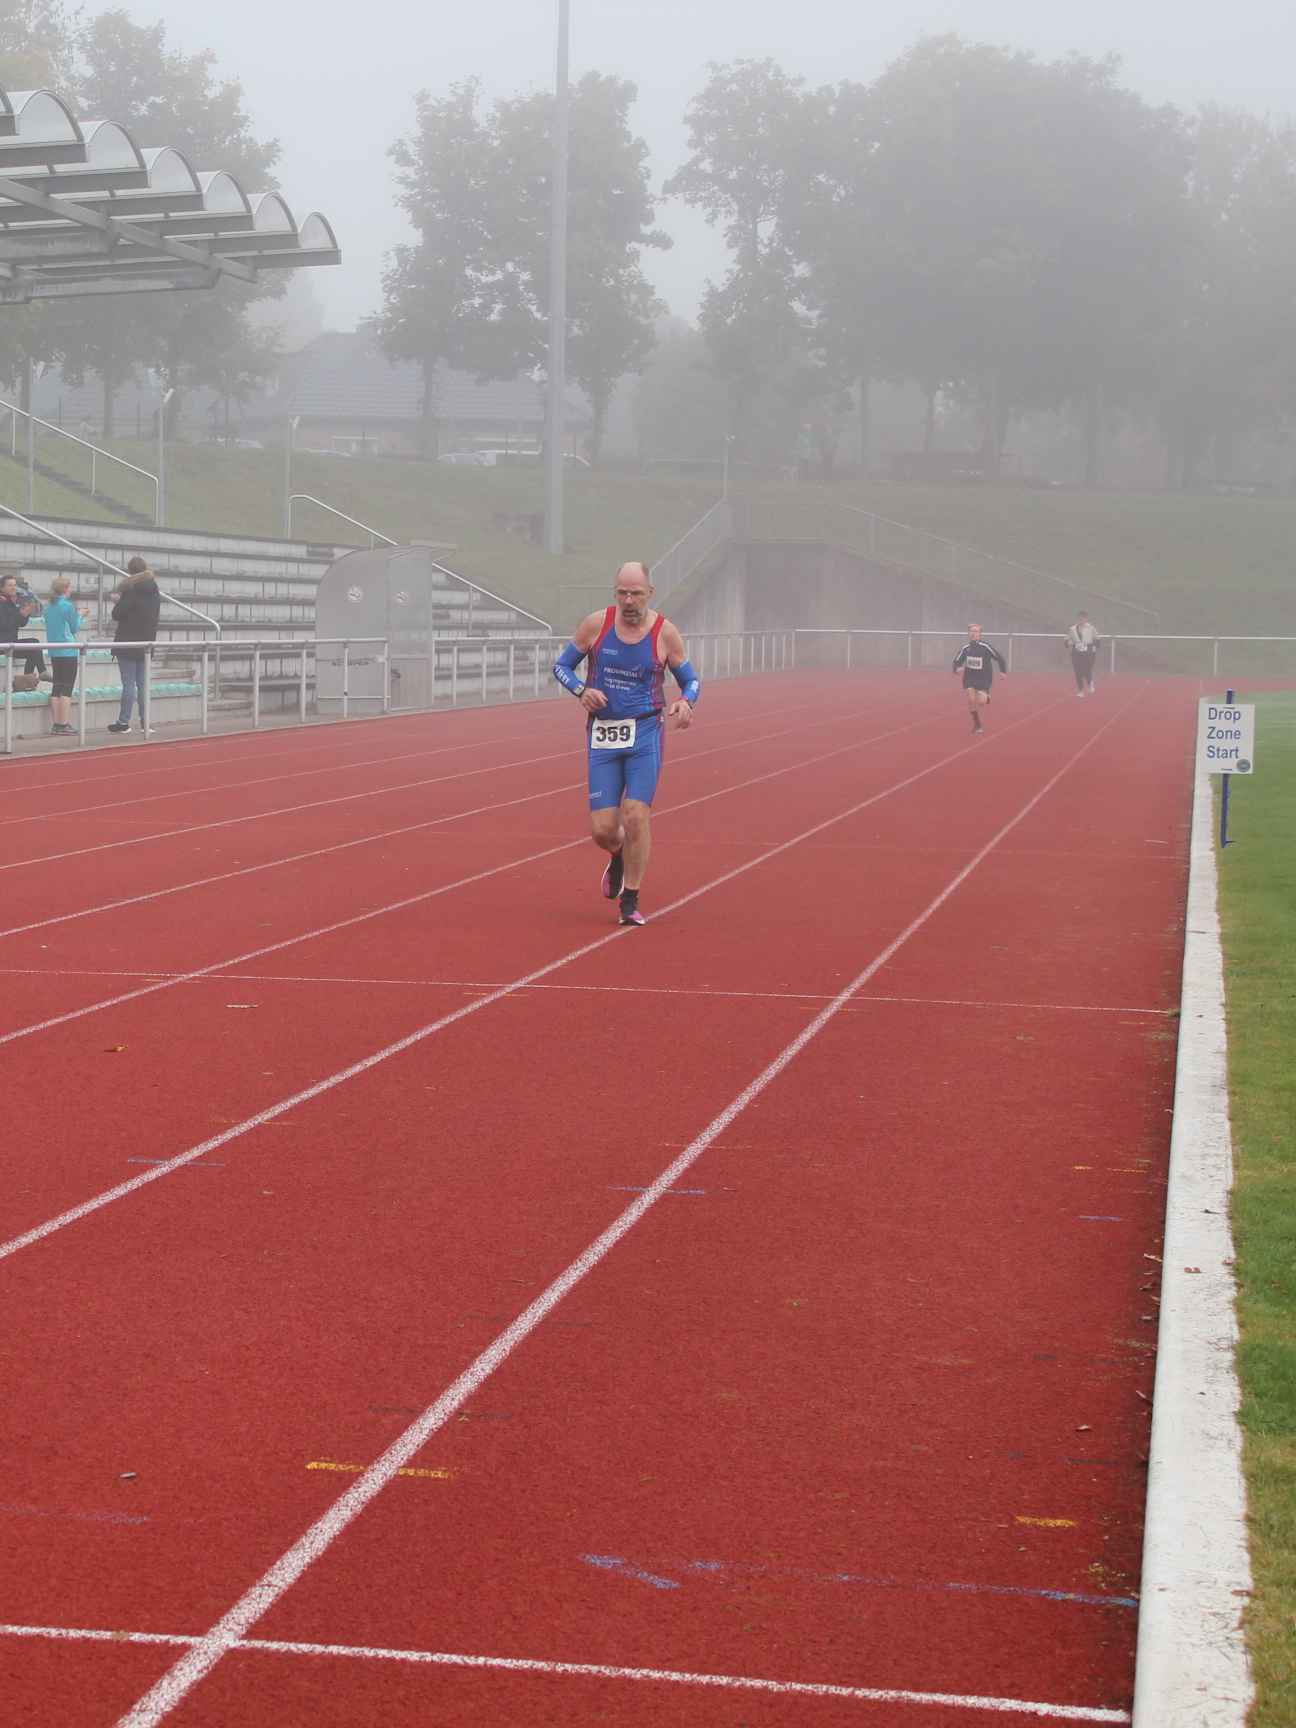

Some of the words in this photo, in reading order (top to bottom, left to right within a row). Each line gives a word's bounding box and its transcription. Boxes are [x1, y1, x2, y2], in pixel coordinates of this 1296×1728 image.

[1207, 707, 1241, 724] Drop
[595, 725, 631, 742] 359
[1207, 726, 1241, 740] Zone
[1207, 745, 1239, 759] Start
